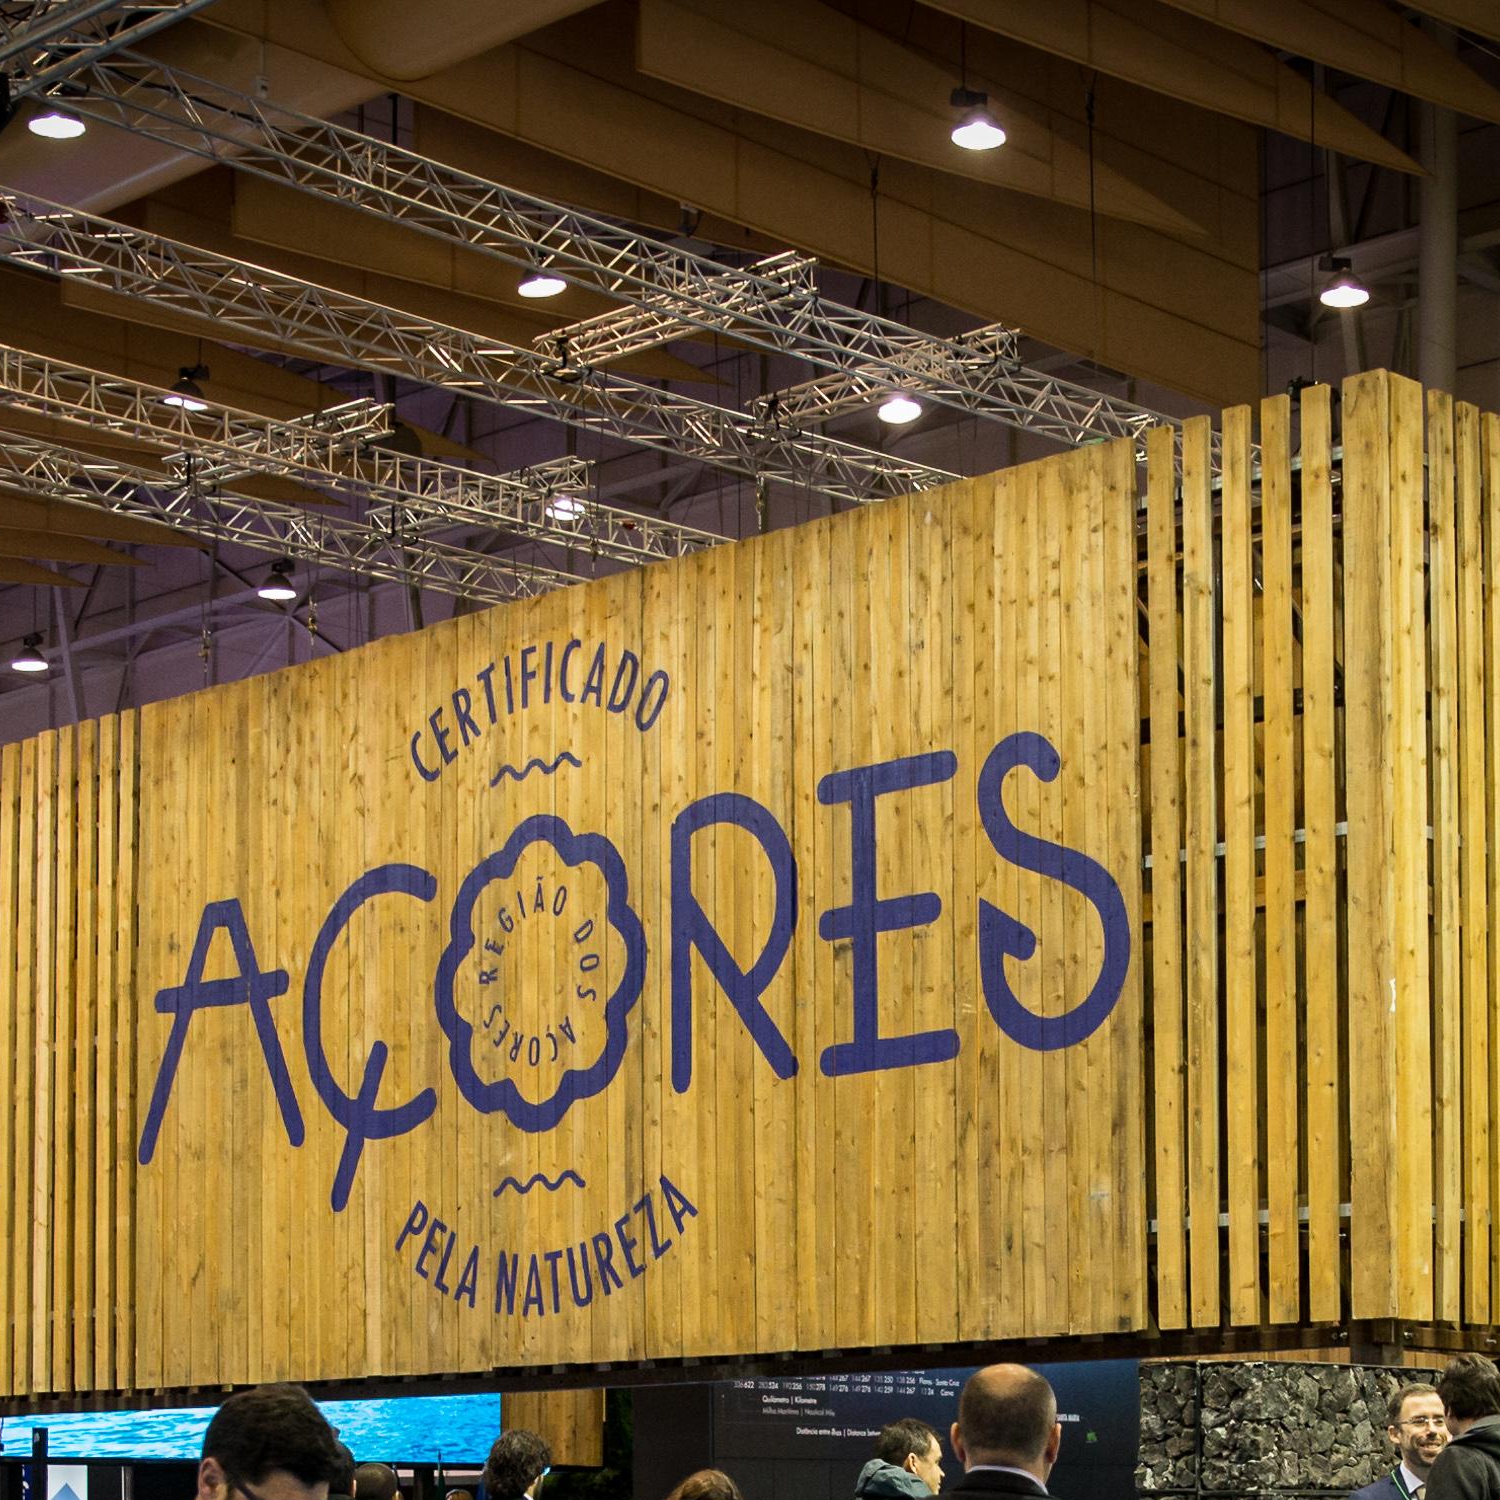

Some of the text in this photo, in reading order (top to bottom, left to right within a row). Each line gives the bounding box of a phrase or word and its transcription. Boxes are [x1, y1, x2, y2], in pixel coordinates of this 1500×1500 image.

[409, 637, 670, 783] CERTIFICADO
[138, 730, 1131, 1212] AÇORES
[479, 876, 600, 1067] REGIÃO DOS AÇORES
[395, 1174, 698, 1318] PELA NATUREZA
